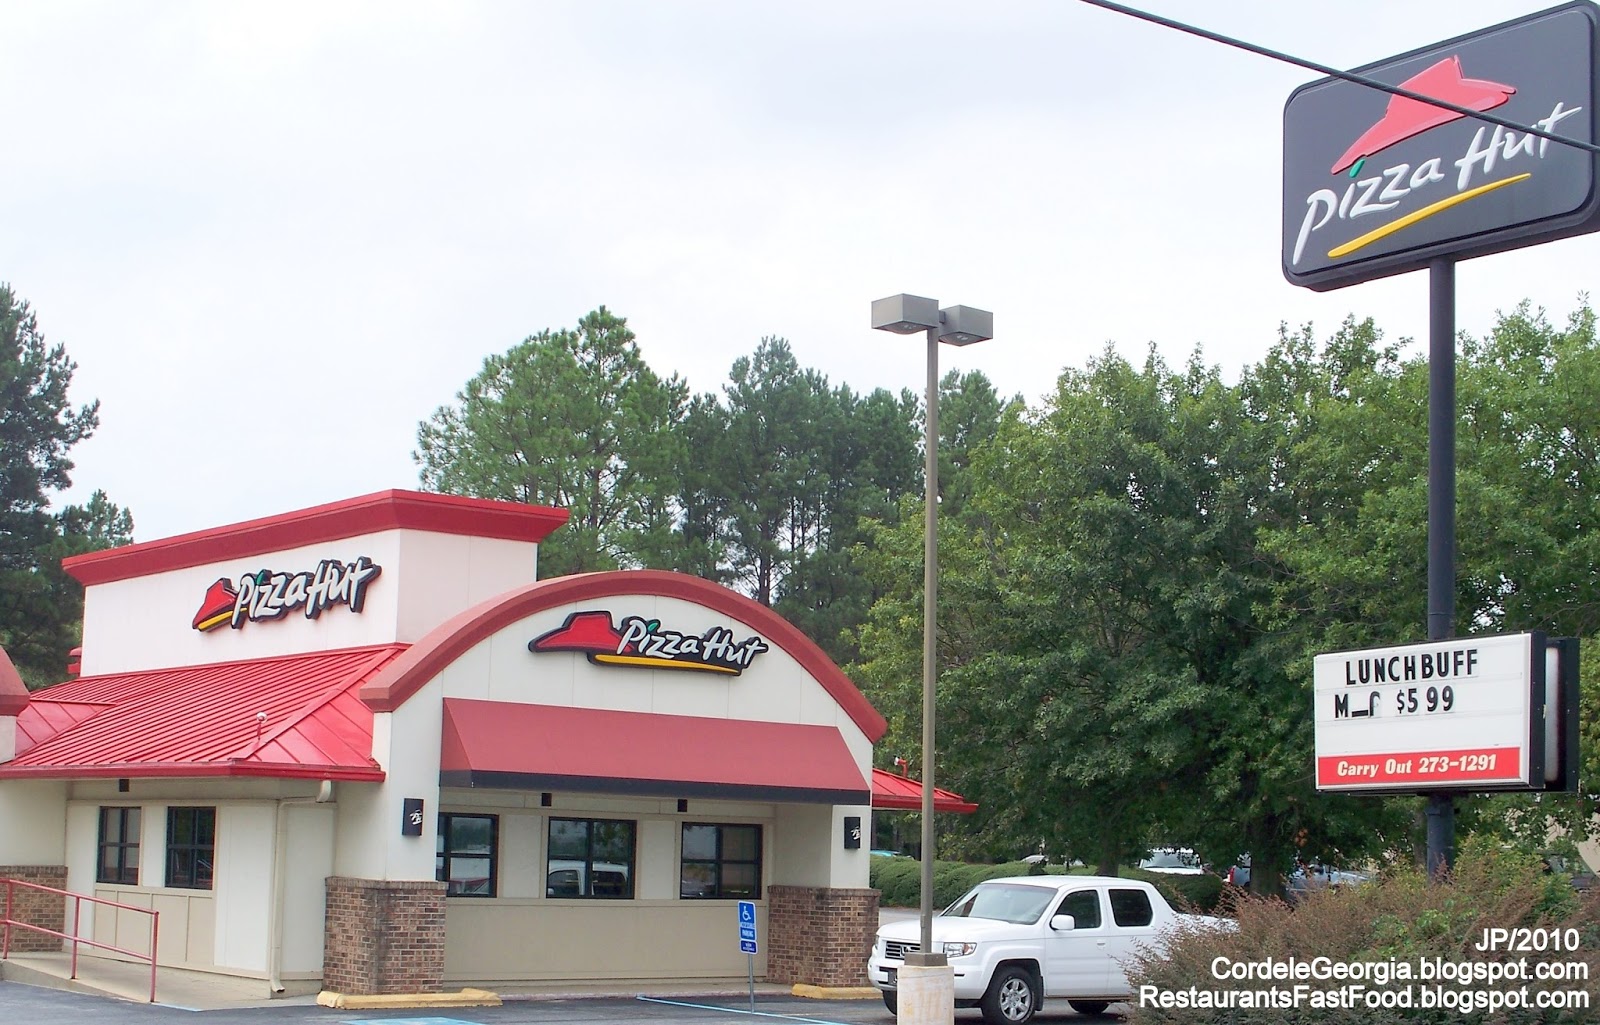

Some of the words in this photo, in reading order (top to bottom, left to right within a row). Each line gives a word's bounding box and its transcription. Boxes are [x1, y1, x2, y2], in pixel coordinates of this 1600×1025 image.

[1292, 157, 1445, 266] Pizza
[1454, 101, 1583, 192] Hut
[231, 569, 309, 630] Pizza
[305, 556, 374, 620] Hut
[617, 619, 699, 659] Pizza
[702, 630, 766, 665] Hut
[1337, 761, 1379, 778] Carry
[1385, 759, 1412, 774] Out
[1418, 754, 1497, 773] 273-1291
